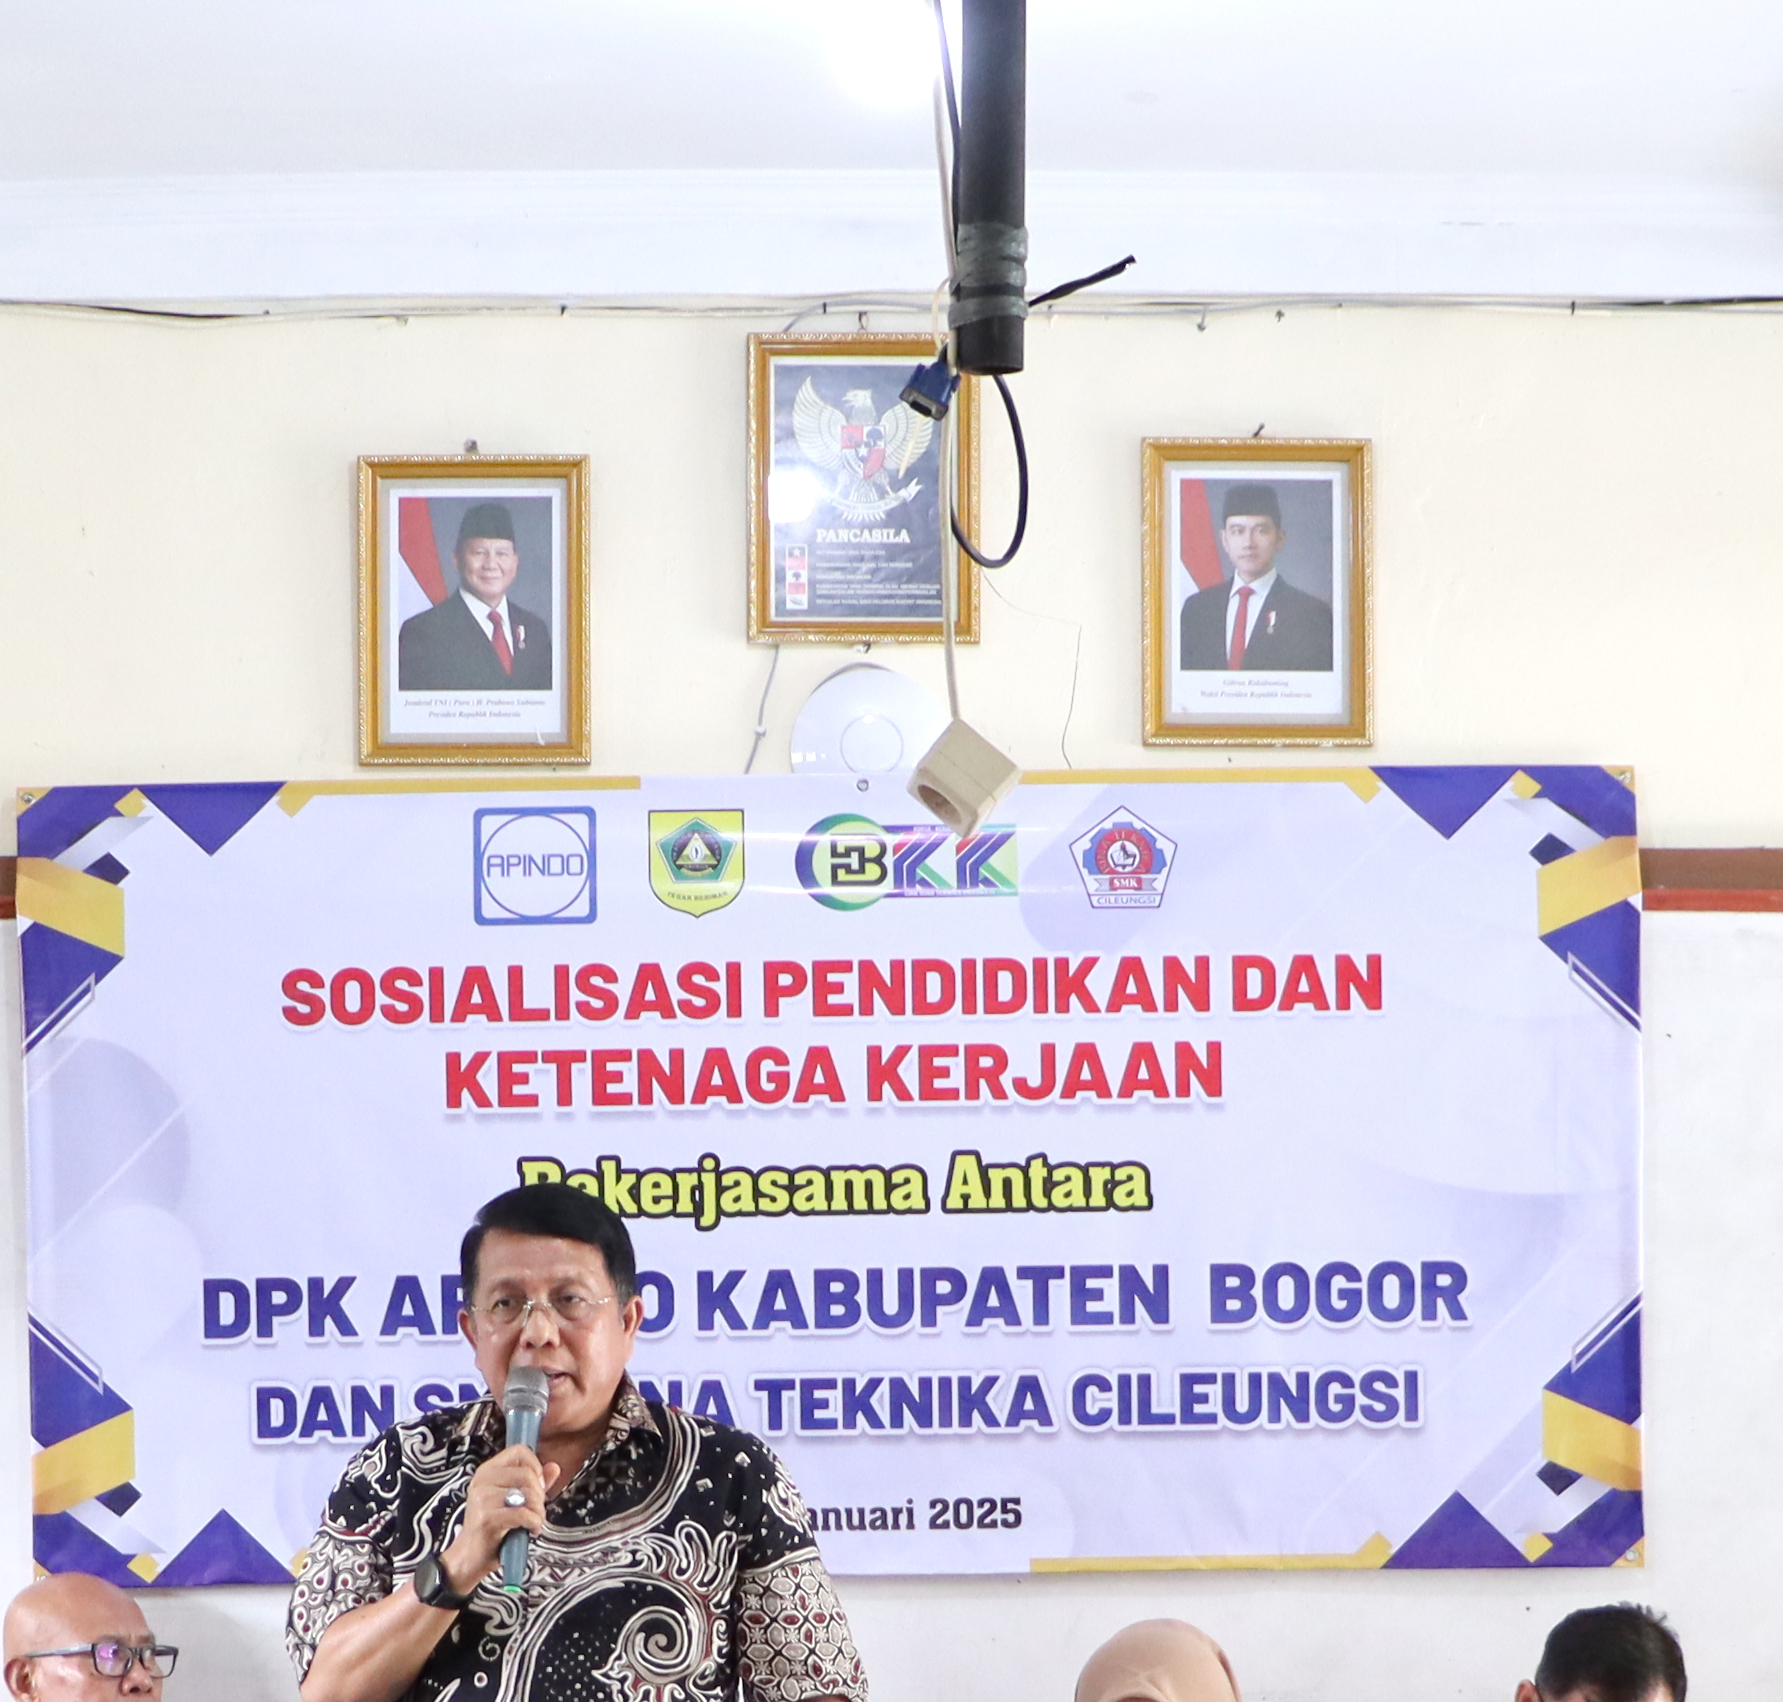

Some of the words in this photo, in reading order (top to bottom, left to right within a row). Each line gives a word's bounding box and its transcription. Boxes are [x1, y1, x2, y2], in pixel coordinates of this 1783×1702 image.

[815, 528, 911, 543] PANCASILA
[486, 853, 585, 878] APINDO
[1112, 878, 1139, 889] SMK
[1096, 896, 1156, 905] CILEUNGSI
[281, 961, 742, 1026] SOSIALISASI
[763, 955, 1211, 1018] PENDIDIKAN
[1232, 953, 1382, 1012] DAN
[445, 1046, 847, 1109] KETENAGA
[866, 1040, 1222, 1102] KERJAAN
[943, 1151, 1152, 1213] Antara
[203, 1276, 358, 1339] DPK
[697, 1264, 1170, 1331] KABUPATEN
[1209, 1261, 1468, 1324] BOGOR
[256, 1383, 396, 1439] DAN
[753, 1376, 1054, 1431] TEKNIKA
[1071, 1369, 1419, 1427] CILEUNGSI
[807, 1498, 915, 1531] anuari
[928, 1497, 1023, 1530] 2025
